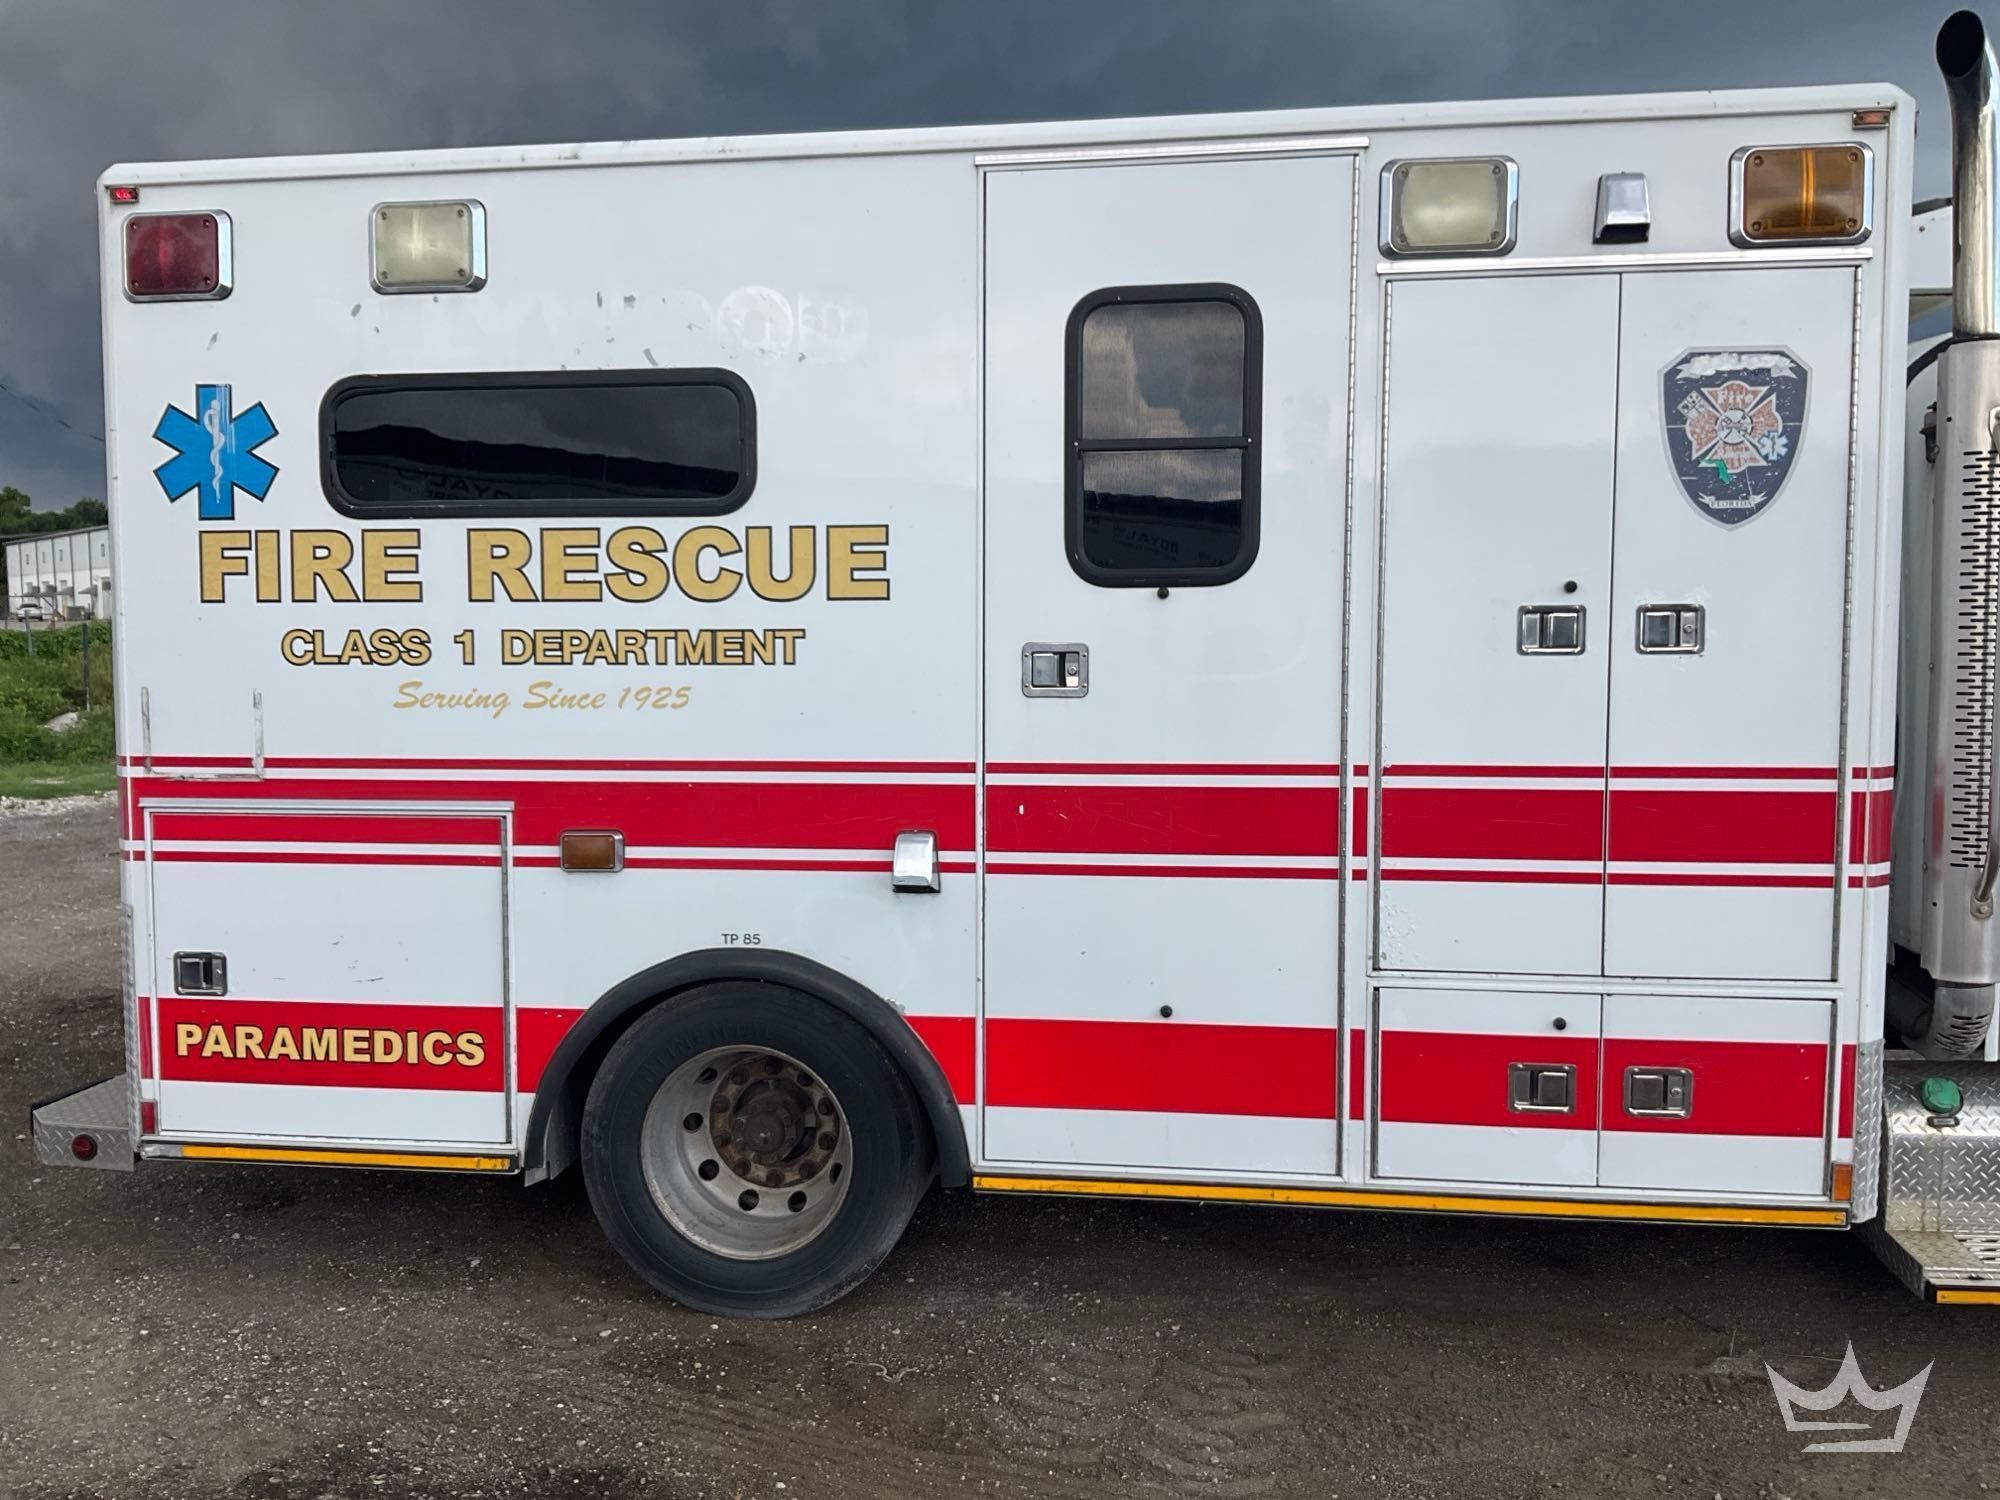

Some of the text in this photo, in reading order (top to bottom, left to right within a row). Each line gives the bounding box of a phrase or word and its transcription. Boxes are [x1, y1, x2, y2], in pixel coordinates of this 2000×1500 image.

[199, 525, 890, 603] FIRE RESCUE
[281, 628, 806, 666] CLASS 1 DEPARTMENT
[393, 680, 693, 719] Serving Since 1925
[721, 933, 761, 945] TP 85
[175, 1022, 487, 1067] PARAMEDICS
